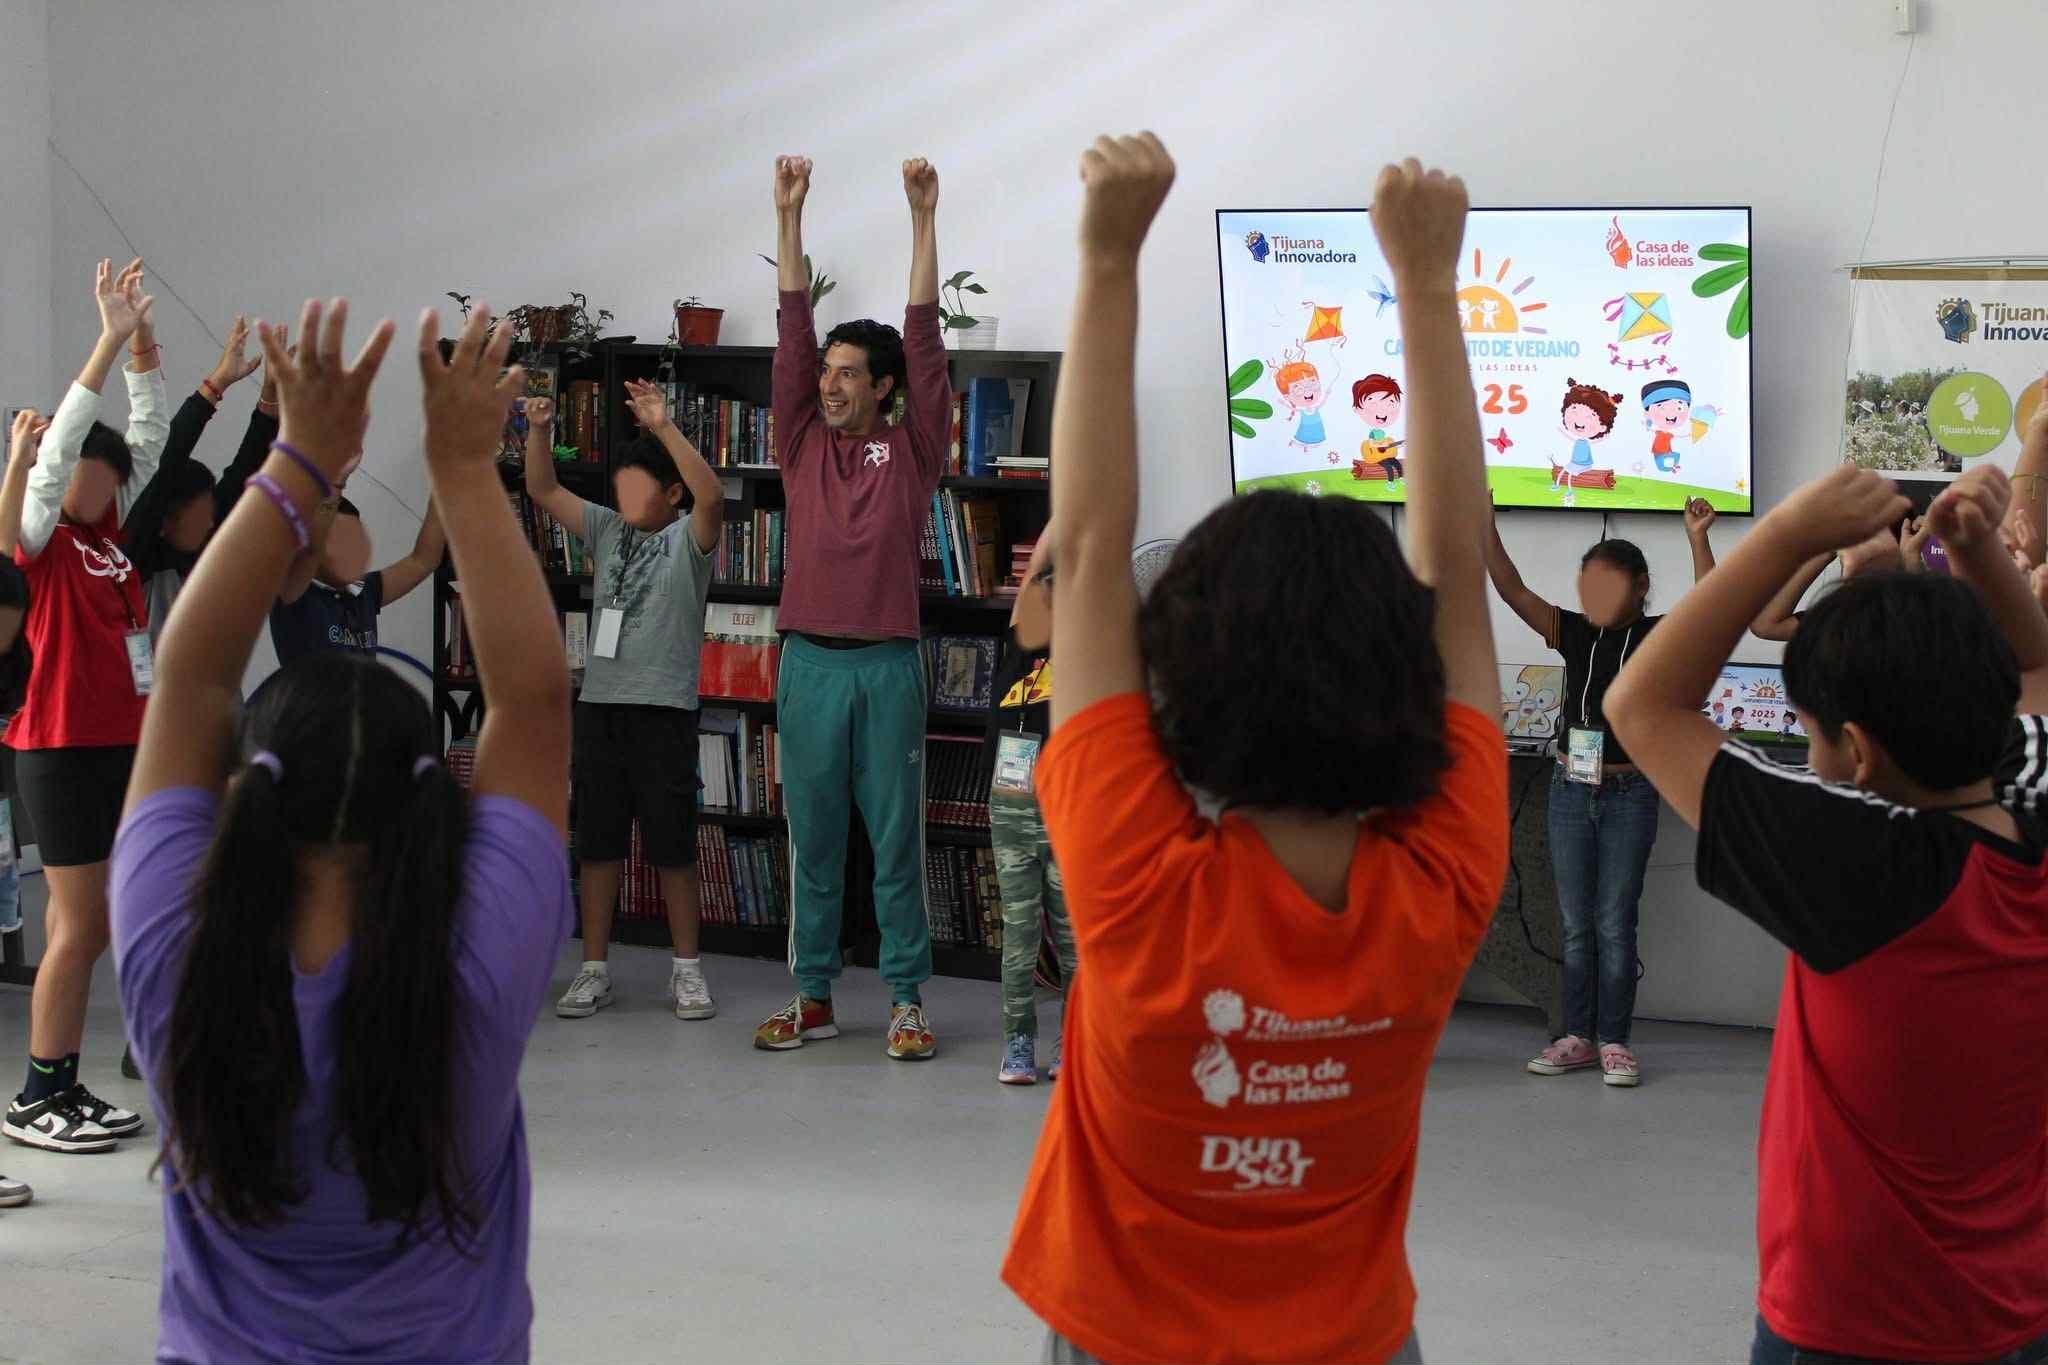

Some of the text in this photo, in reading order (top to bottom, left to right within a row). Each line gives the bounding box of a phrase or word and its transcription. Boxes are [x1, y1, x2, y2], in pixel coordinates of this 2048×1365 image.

[1271, 236, 1324, 252] Tijuana
[1636, 239, 1689, 253] Casa de
[1274, 250, 1357, 263] Innovadora
[1636, 254, 1694, 267] las ideas
[1980, 303, 2048, 326] Tijuan
[1491, 339, 1513, 357] DE
[1514, 339, 1580, 358] VERANO
[1482, 383, 1529, 415] 25
[734, 613, 755, 625] LIFE
[1750, 709, 1776, 719] 2025
[1247, 1057, 1346, 1083] Casa de
[1243, 1080, 1352, 1104] las ideas
